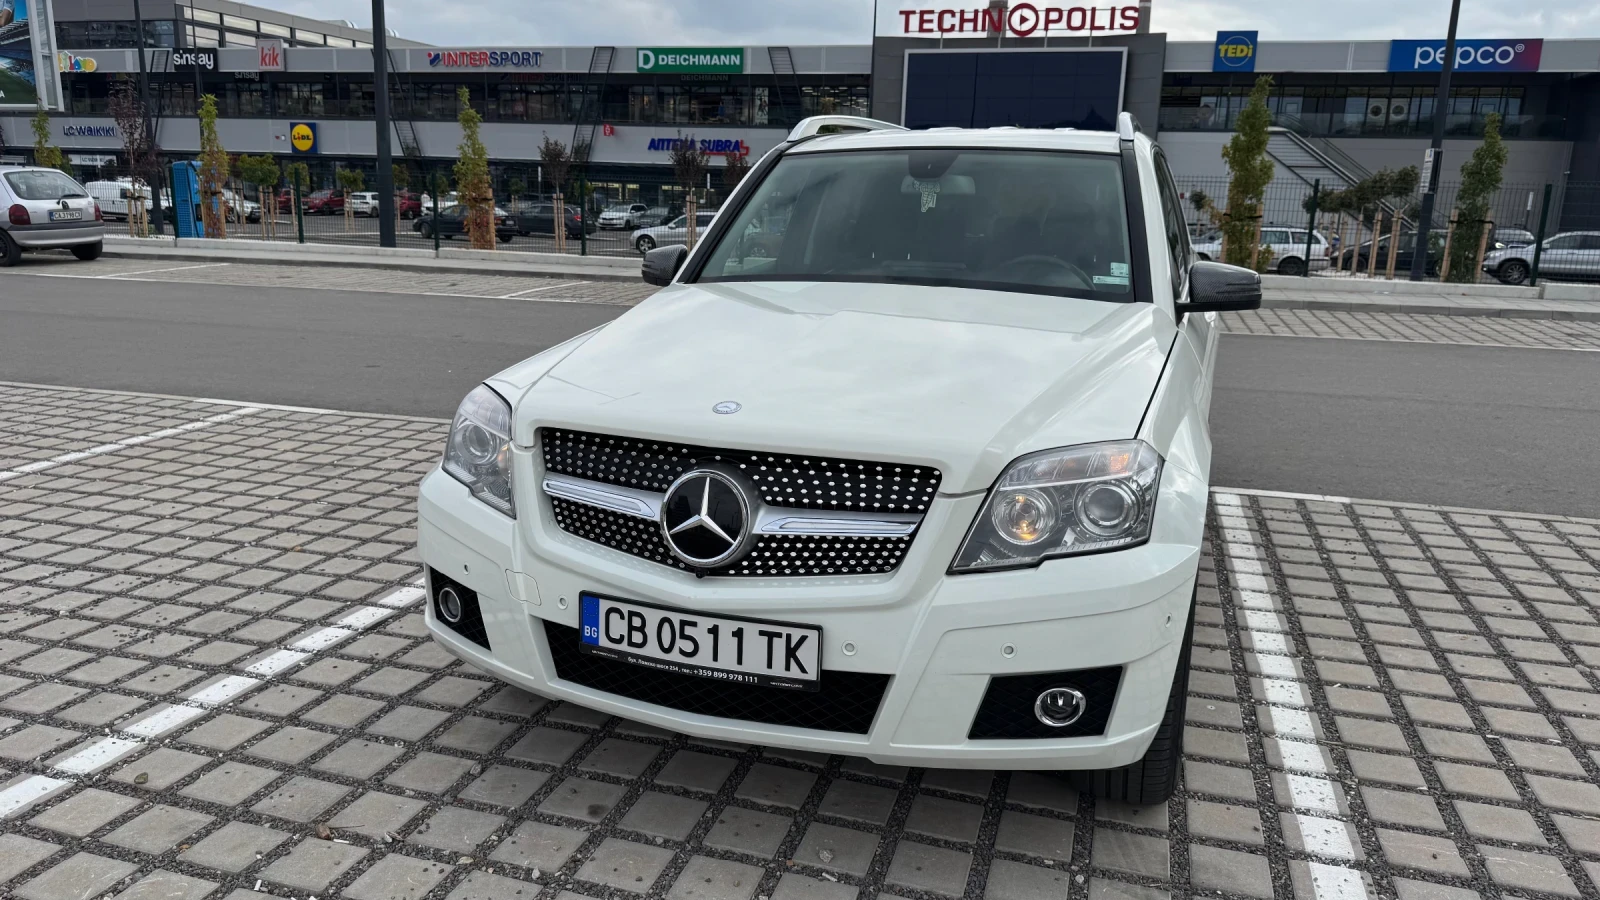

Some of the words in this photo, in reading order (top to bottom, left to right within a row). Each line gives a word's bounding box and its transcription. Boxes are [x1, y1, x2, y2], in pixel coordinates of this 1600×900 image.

[899, 2, 1139, 37] TECHNOPOLIS
[173, 50, 214, 70] sinsay
[442, 51, 543, 67] INTERSPORT
[658, 54, 740, 66] DEICHMANN
[1414, 46, 1515, 69] pepco
[700, 139, 740, 153] SUBRA
[584, 625, 598, 638] BG
[604, 606, 648, 649] CB
[656, 616, 744, 666] 0511
[758, 629, 809, 675] TK
[693, 668, 712, 677] +359
[713, 670, 727, 679] 899
[728, 672, 743, 682] 978
[744, 675, 758, 683] 111
